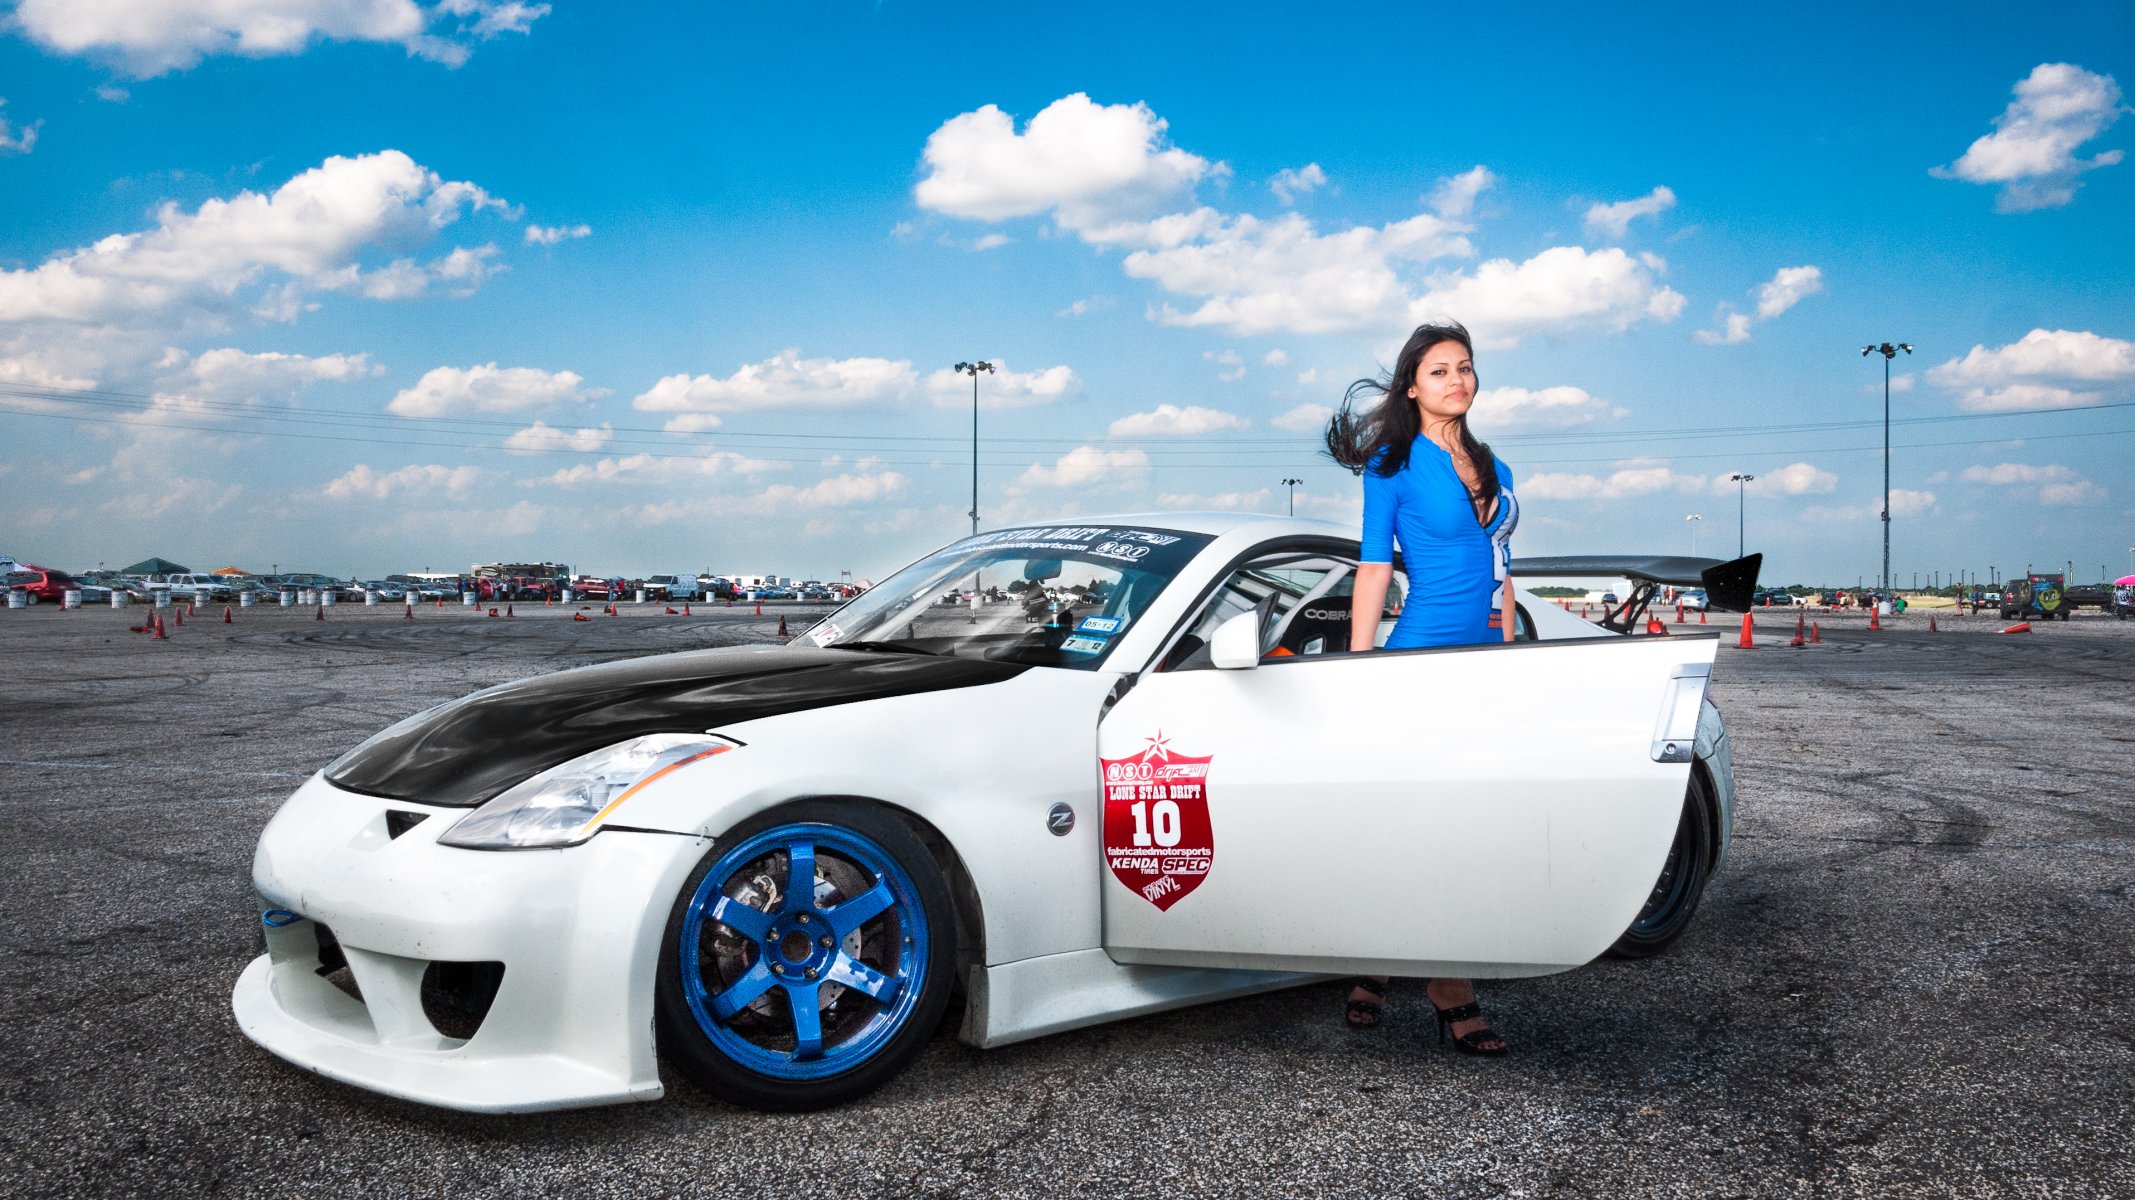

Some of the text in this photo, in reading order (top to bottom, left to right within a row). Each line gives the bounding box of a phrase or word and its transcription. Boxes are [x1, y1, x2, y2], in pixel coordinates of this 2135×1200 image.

[996, 528, 1053, 542] STAR
[1043, 527, 1111, 541] DRIFT
[1097, 542, 1149, 557] NST
[1108, 763, 1152, 780] NST
[1109, 785, 1201, 800] LONE STAR DRIFT
[1131, 800, 1181, 847] 10
[1107, 847, 1211, 857] fabricatedmotorsports
[1112, 858, 1209, 871] KENDA SPEC
[1143, 876, 1181, 902] VINYL
